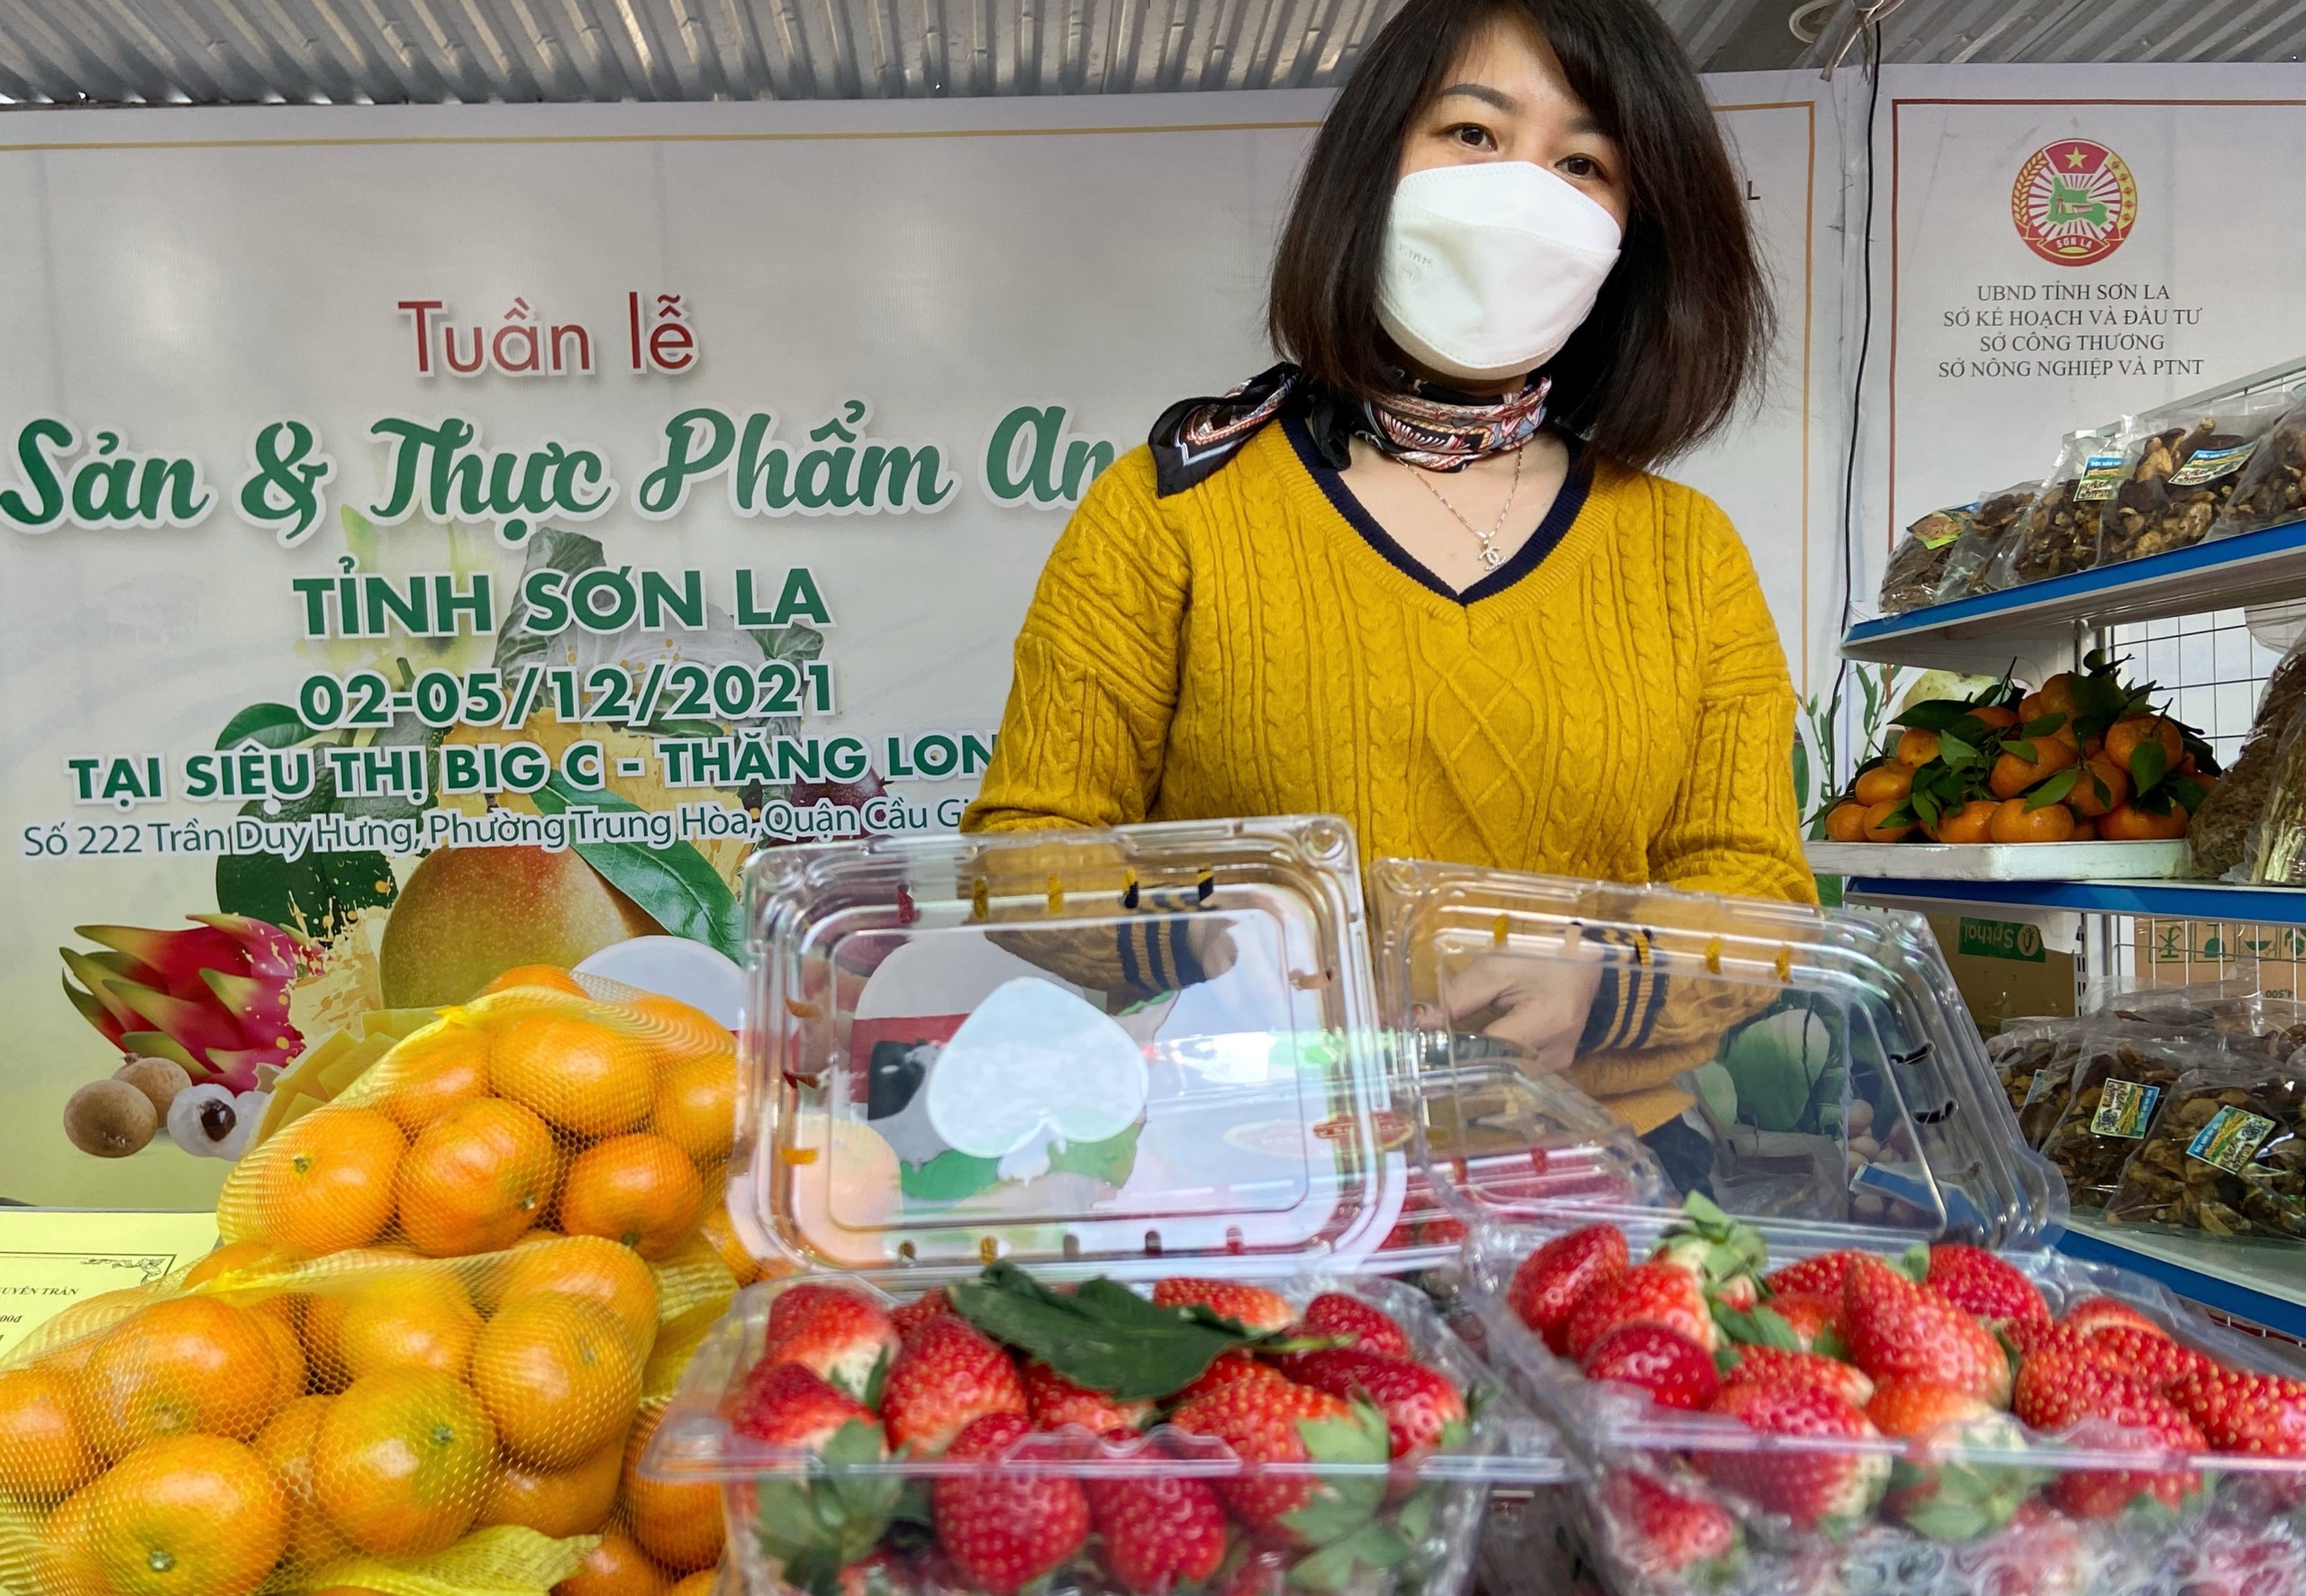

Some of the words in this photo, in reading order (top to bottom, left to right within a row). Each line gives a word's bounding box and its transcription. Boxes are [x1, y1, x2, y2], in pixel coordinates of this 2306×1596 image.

[2080, 238, 2093, 249] LA
[1978, 285, 2036, 302] UBND
[2042, 280, 2090, 301] TỈNH
[2097, 283, 2138, 300] SƠN
[2144, 285, 2170, 300] LA
[398, 297, 590, 372] Tuần
[629, 291, 694, 369] lễ
[1944, 307, 1970, 327] SỞ
[2010, 310, 2083, 330] HOẠCH
[2089, 305, 2117, 325] VÀ
[2174, 307, 2203, 325] TƯ
[1980, 331, 2006, 352] SỞ
[2012, 331, 2071, 352] CÔNG
[2076, 332, 2165, 351] THƯƠNG
[1938, 358, 1966, 378] SỞ
[1971, 357, 2031, 377] NÔNG
[2038, 358, 2113, 379] NGHIỆP
[2119, 356, 2147, 376] VÀ
[2154, 359, 2204, 376] PTNT
[0, 419, 209, 525] Sản
[241, 421, 328, 539] &
[370, 418, 612, 541] Thực
[640, 400, 954, 512] Phẩm
[986, 406, 1114, 502] An
[293, 556, 492, 635] TỈNH
[525, 566, 704, 630] SƠN
[736, 567, 832, 626] LA
[300, 663, 831, 726] 02-05/12/2021
[68, 756, 162, 808] TẠI
[331, 750, 422, 801] THỊ
[446, 746, 545, 790] BIG
[566, 745, 600, 787] C
[658, 731, 867, 783] THĂNG
[23, 821, 68, 856] Số
[77, 825, 142, 855] 222
[148, 818, 225, 853] Trần
[236, 821, 307, 858] Duy
[317, 816, 422, 854] Hưng,
[430, 812, 566, 848] Phường
[571, 810, 671, 845] Trung
[682, 806, 757, 839] Hòa,
[765, 803, 856, 839] Quận
[865, 796, 928, 830] Cầu
[2265, 988, 2293, 999] 4,500
